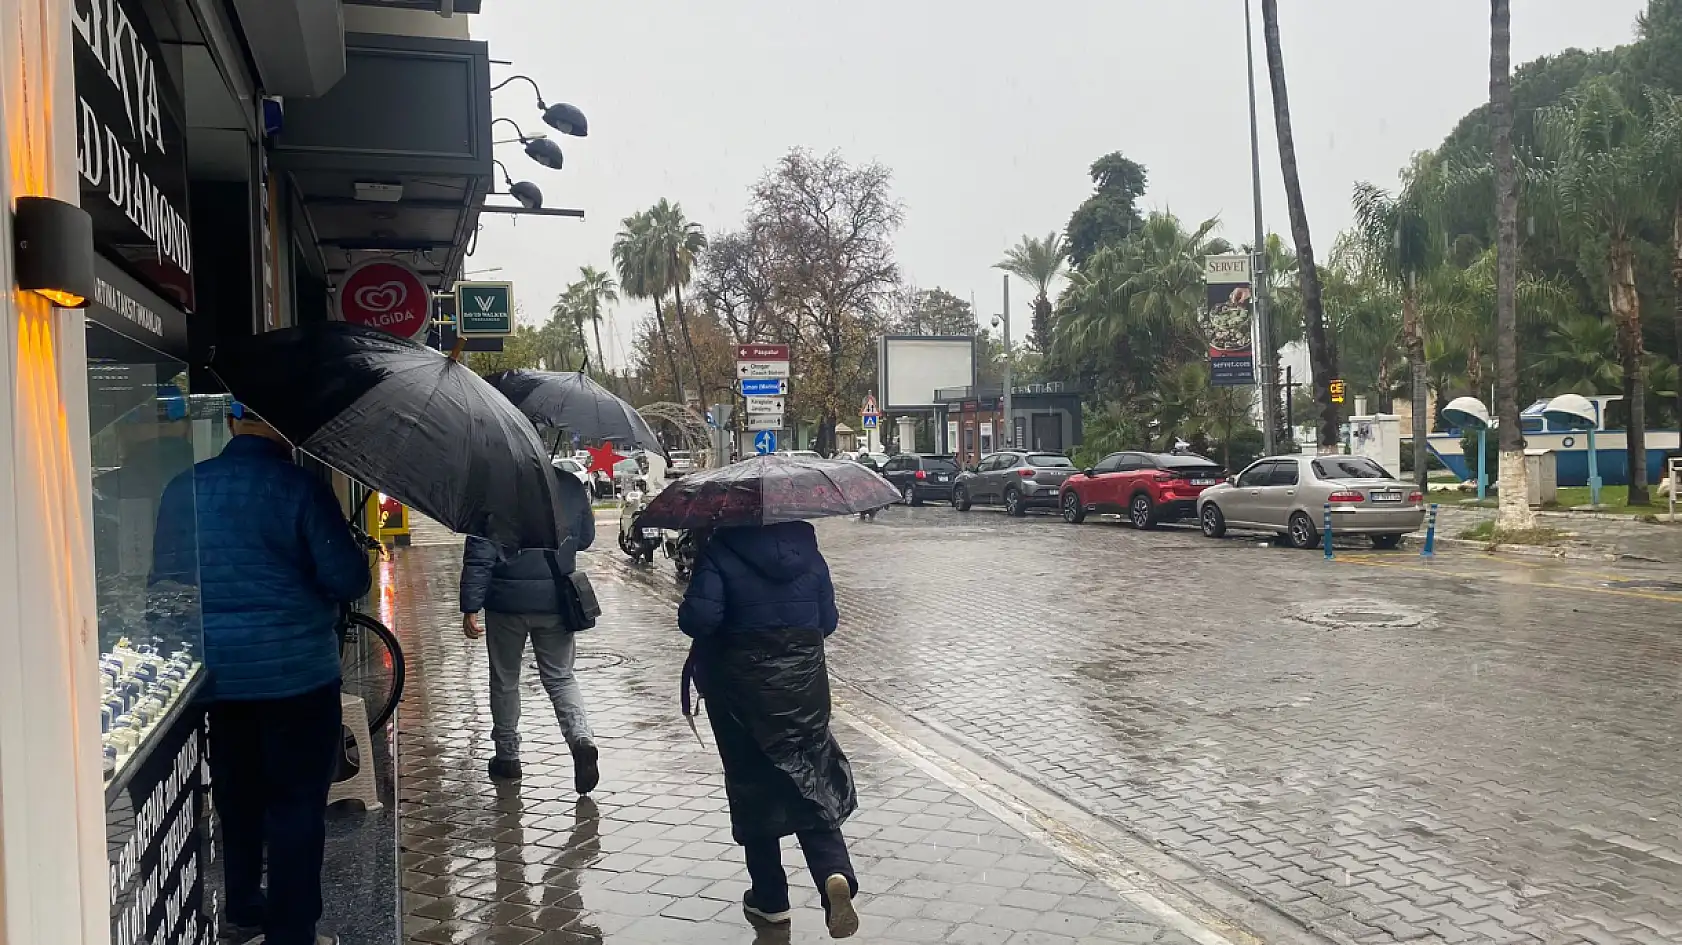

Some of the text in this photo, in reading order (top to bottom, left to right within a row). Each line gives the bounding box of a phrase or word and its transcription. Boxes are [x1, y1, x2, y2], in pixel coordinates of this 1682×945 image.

[104, 124, 191, 273] DIAMOND
[1209, 260, 1246, 273] SERVET
[364, 308, 415, 328] ALGIDA
[136, 780, 165, 862] REPAIR
